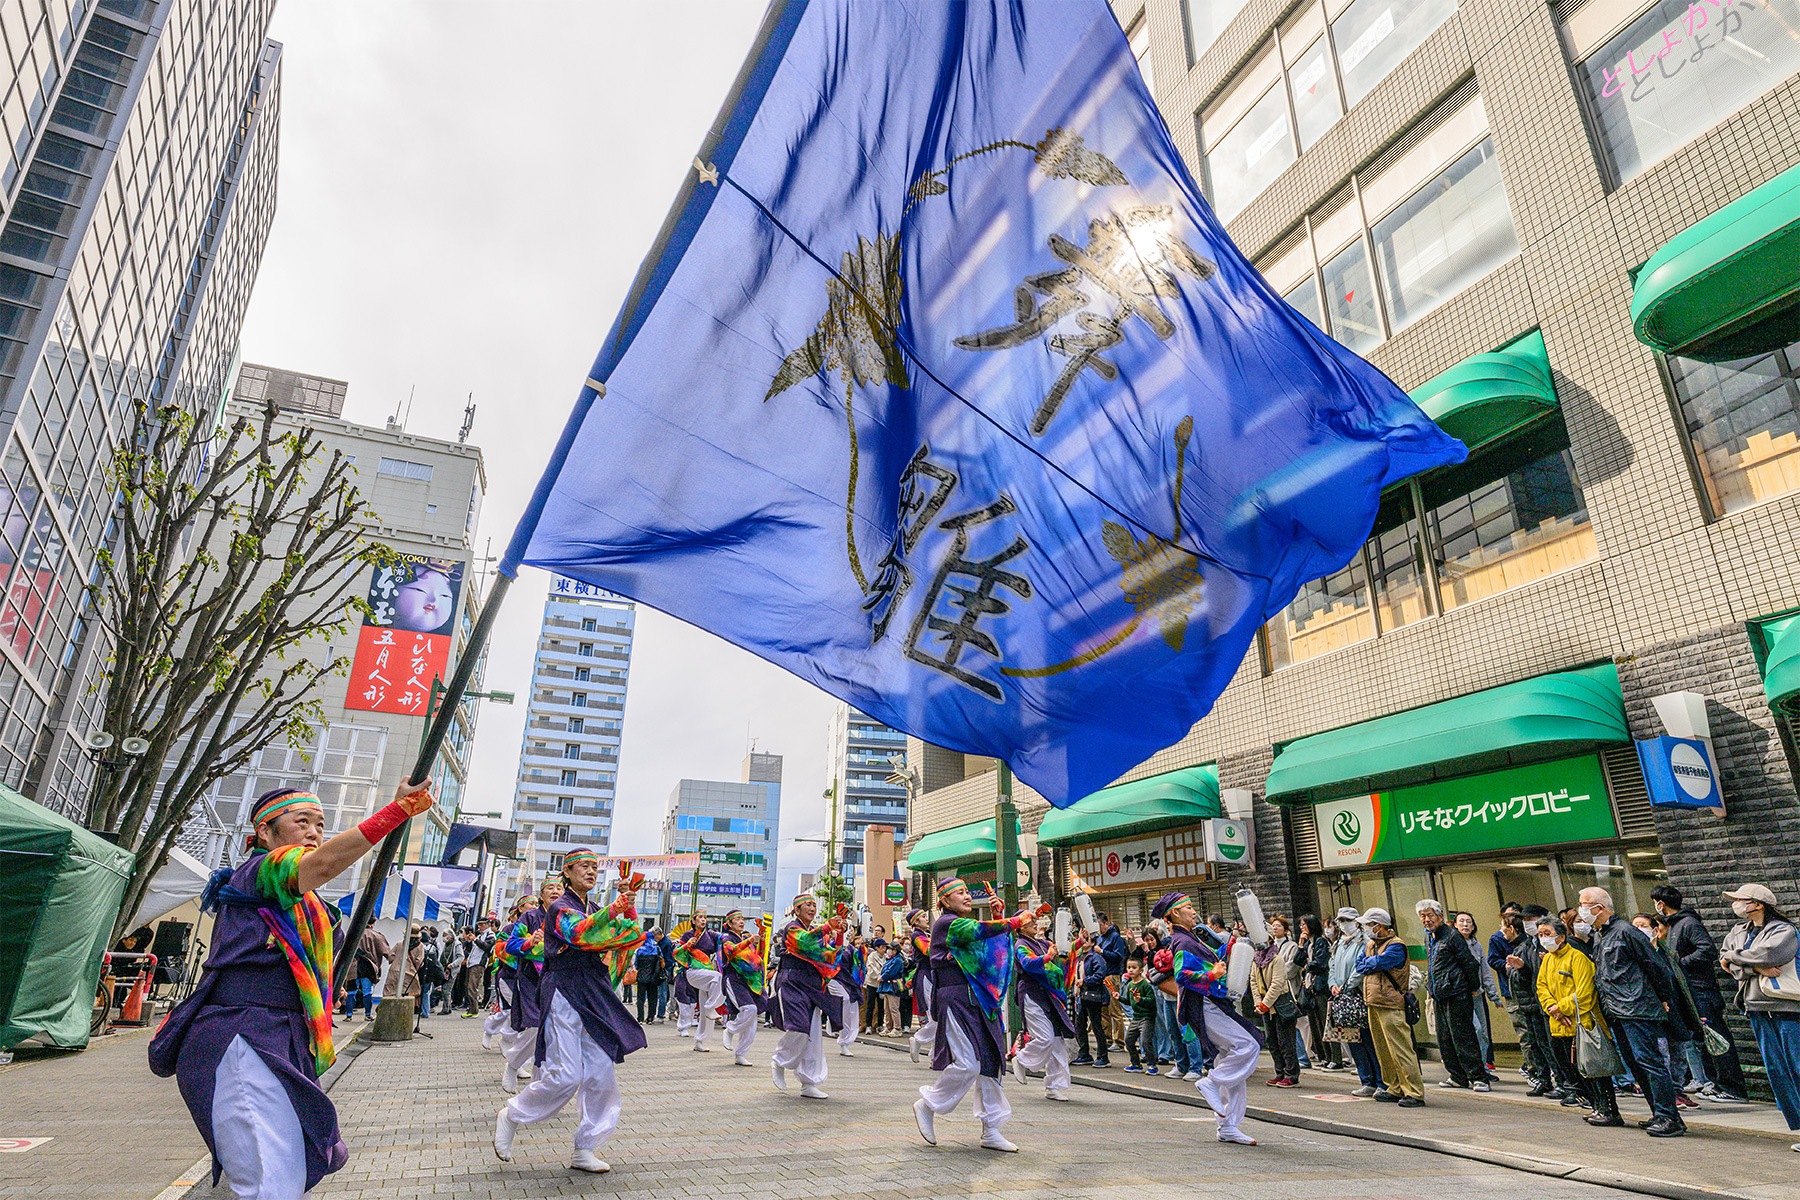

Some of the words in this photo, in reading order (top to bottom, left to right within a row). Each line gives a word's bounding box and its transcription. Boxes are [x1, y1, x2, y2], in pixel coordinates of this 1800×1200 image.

[1602, 0, 1733, 98] としょか
[363, 630, 396, 709] 五月人形
[398, 634, 432, 712] ひな人形
[1400, 788, 1591, 834] りそなクイックロビー
[1122, 850, 1161, 873] 十万石
[1337, 848, 1362, 857] RESONA
